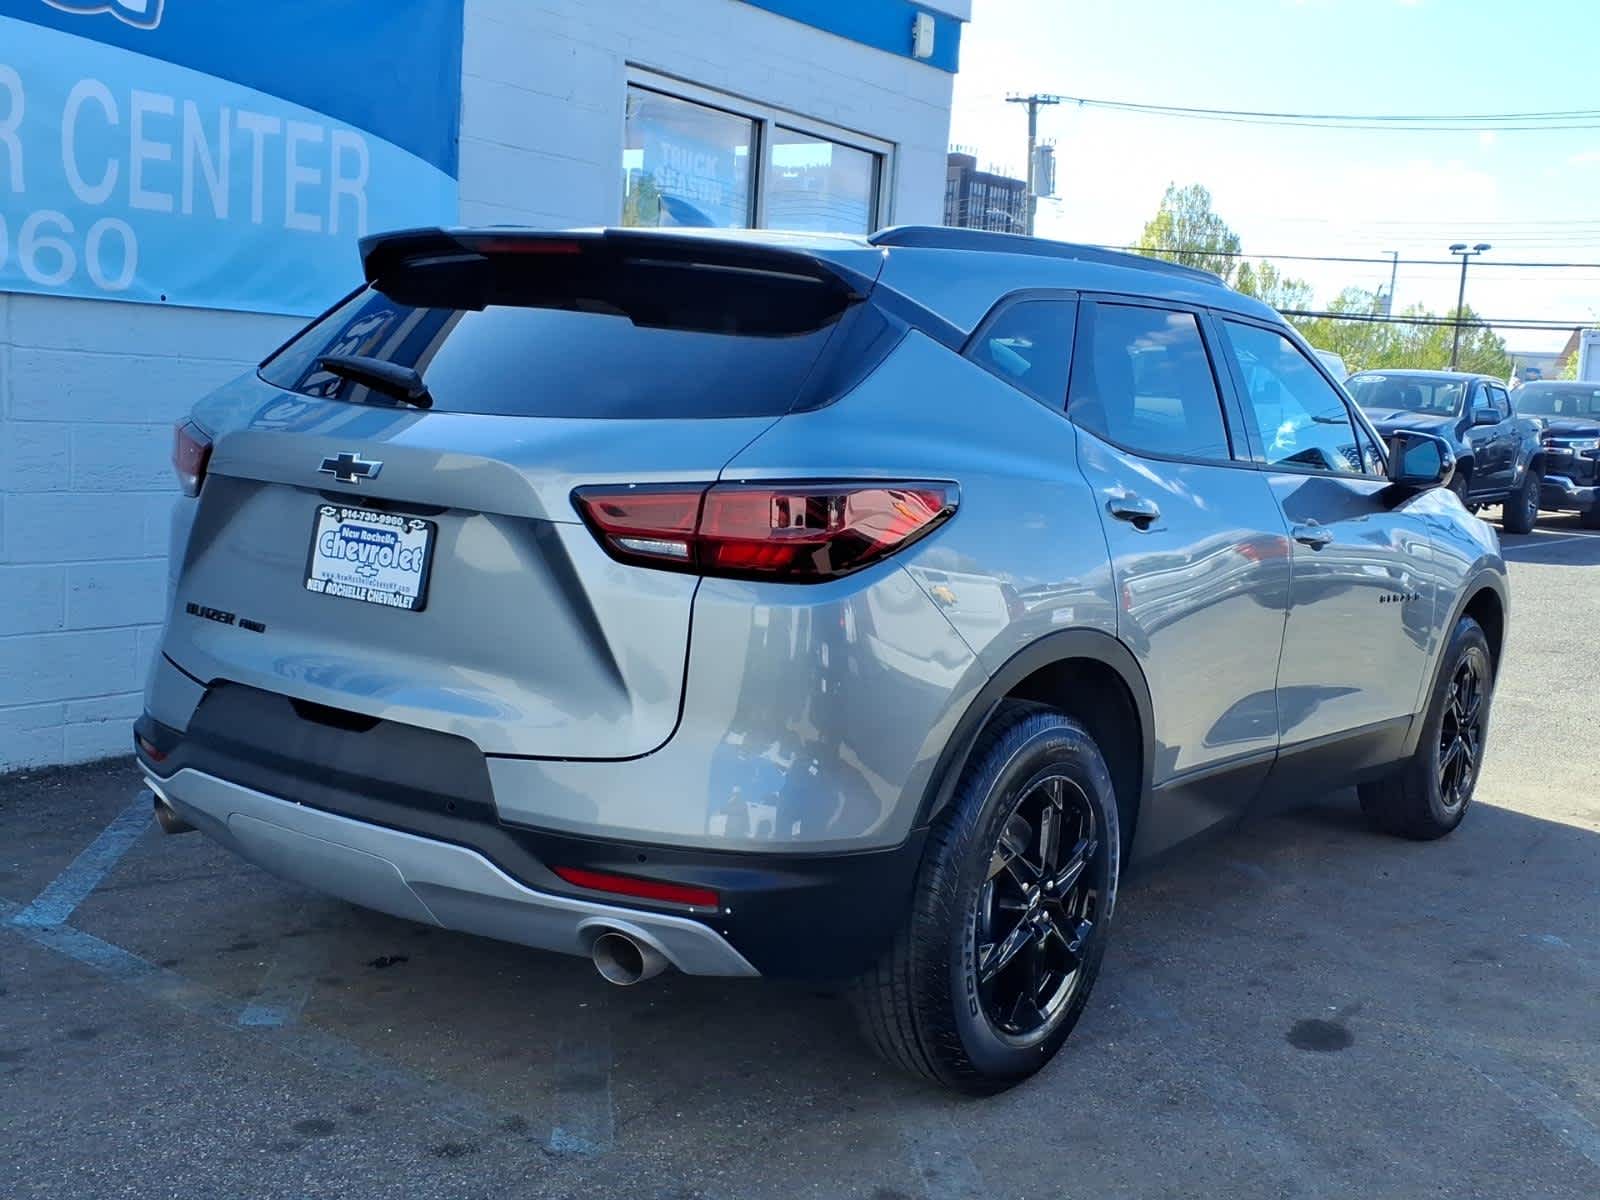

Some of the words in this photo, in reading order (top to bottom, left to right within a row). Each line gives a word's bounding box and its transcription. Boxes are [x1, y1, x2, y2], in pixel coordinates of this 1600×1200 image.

[61, 77, 371, 236] CENTER
[0, 209, 139, 291] 60
[320, 530, 423, 573] Chevrolet
[341, 527, 361, 539] New
[360, 530, 396, 545] Rochelle
[306, 578, 326, 593] NEW
[325, 582, 368, 601] ROCHELLE
[367, 590, 416, 609] CHEVROLET
[186, 602, 236, 626] BLAZER
